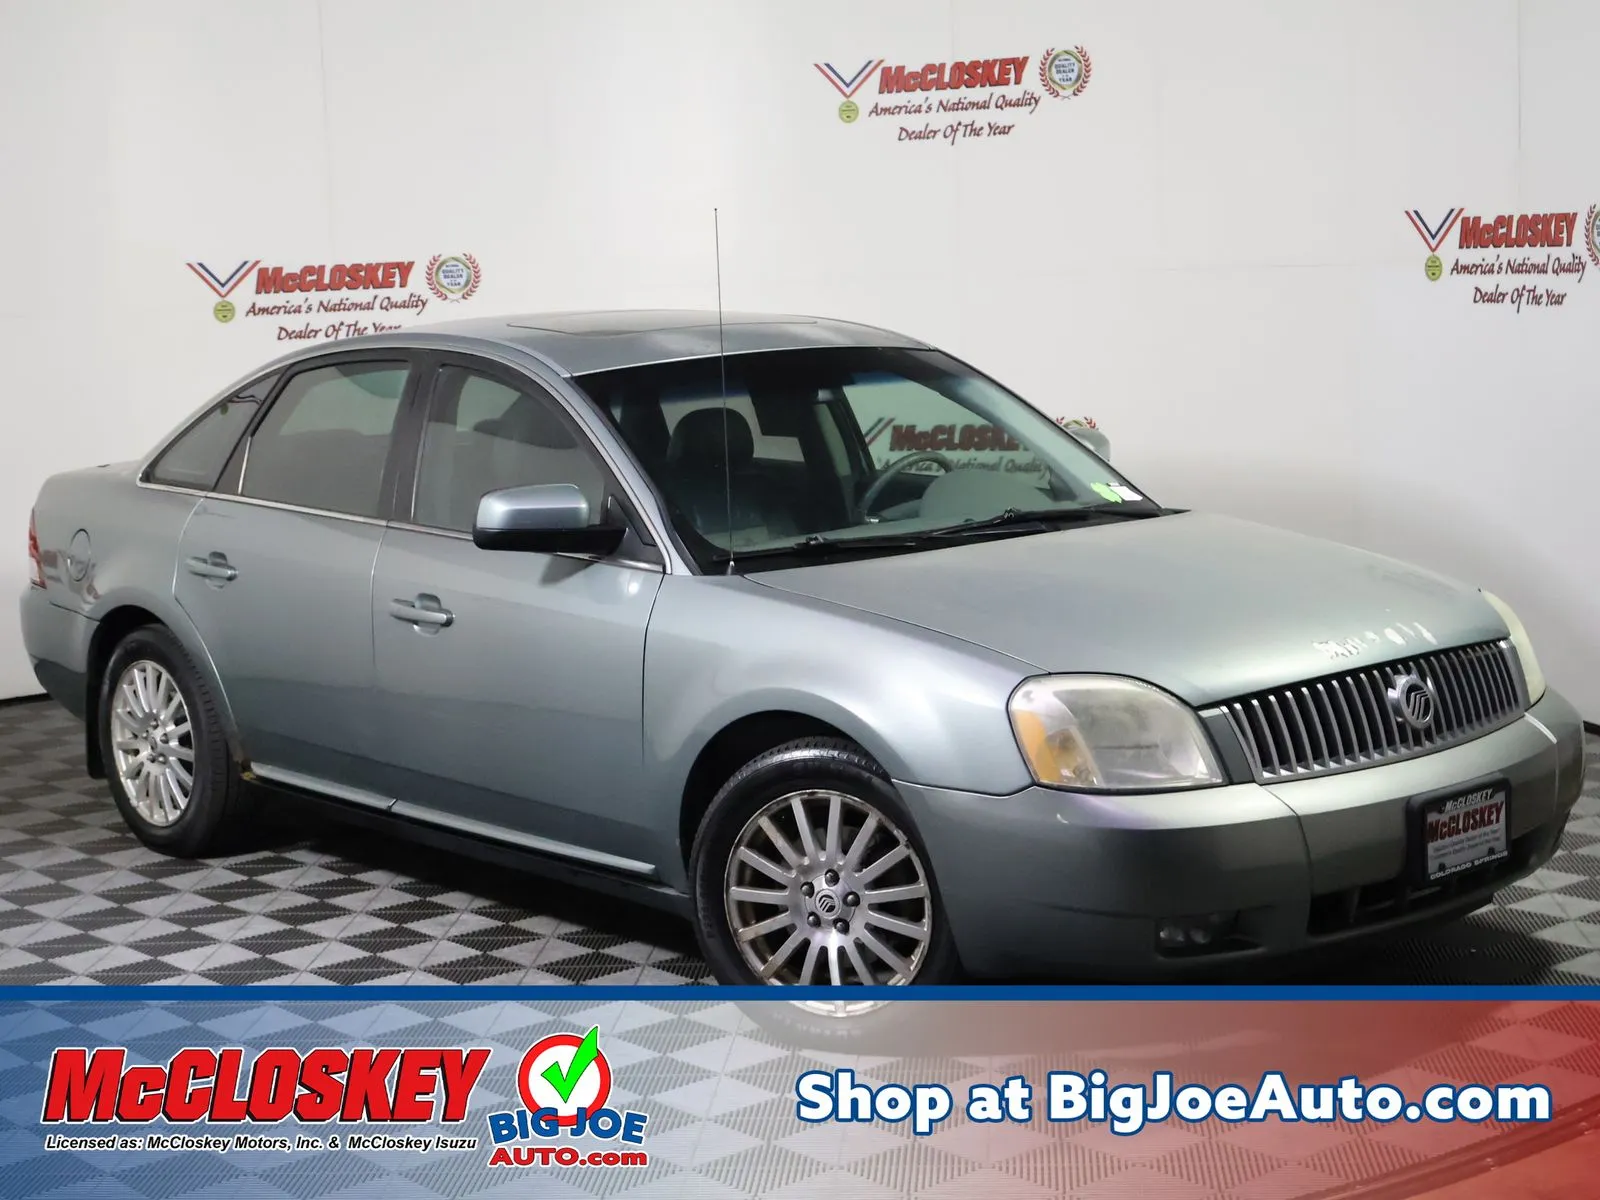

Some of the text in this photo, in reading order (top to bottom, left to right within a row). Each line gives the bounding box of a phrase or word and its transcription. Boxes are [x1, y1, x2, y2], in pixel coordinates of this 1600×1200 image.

[879, 56, 1029, 94] McCLOSKEY
[868, 96, 932, 117] America's
[936, 93, 993, 113] National
[995, 90, 1042, 115] Quality
[898, 120, 1015, 146] Dealer Of The Year
[1458, 212, 1578, 249] McCLOSKEY
[255, 261, 415, 294] McCLOSKEY
[1450, 255, 1502, 276] America's
[1505, 253, 1550, 275] National
[1552, 253, 1587, 283] Quality
[245, 297, 312, 317] America's
[317, 294, 376, 313] National
[379, 293, 428, 315] Quality
[1473, 284, 1567, 314] Dealer Of The Year
[277, 322, 322, 340] Dealer
[325, 320, 344, 341] Of
[345, 320, 369, 337] The
[890, 424, 1029, 451] McCLOSKE
[1444, 788, 1493, 813] McCLOSKEY
[1427, 801, 1505, 843] McCLOSKEY
